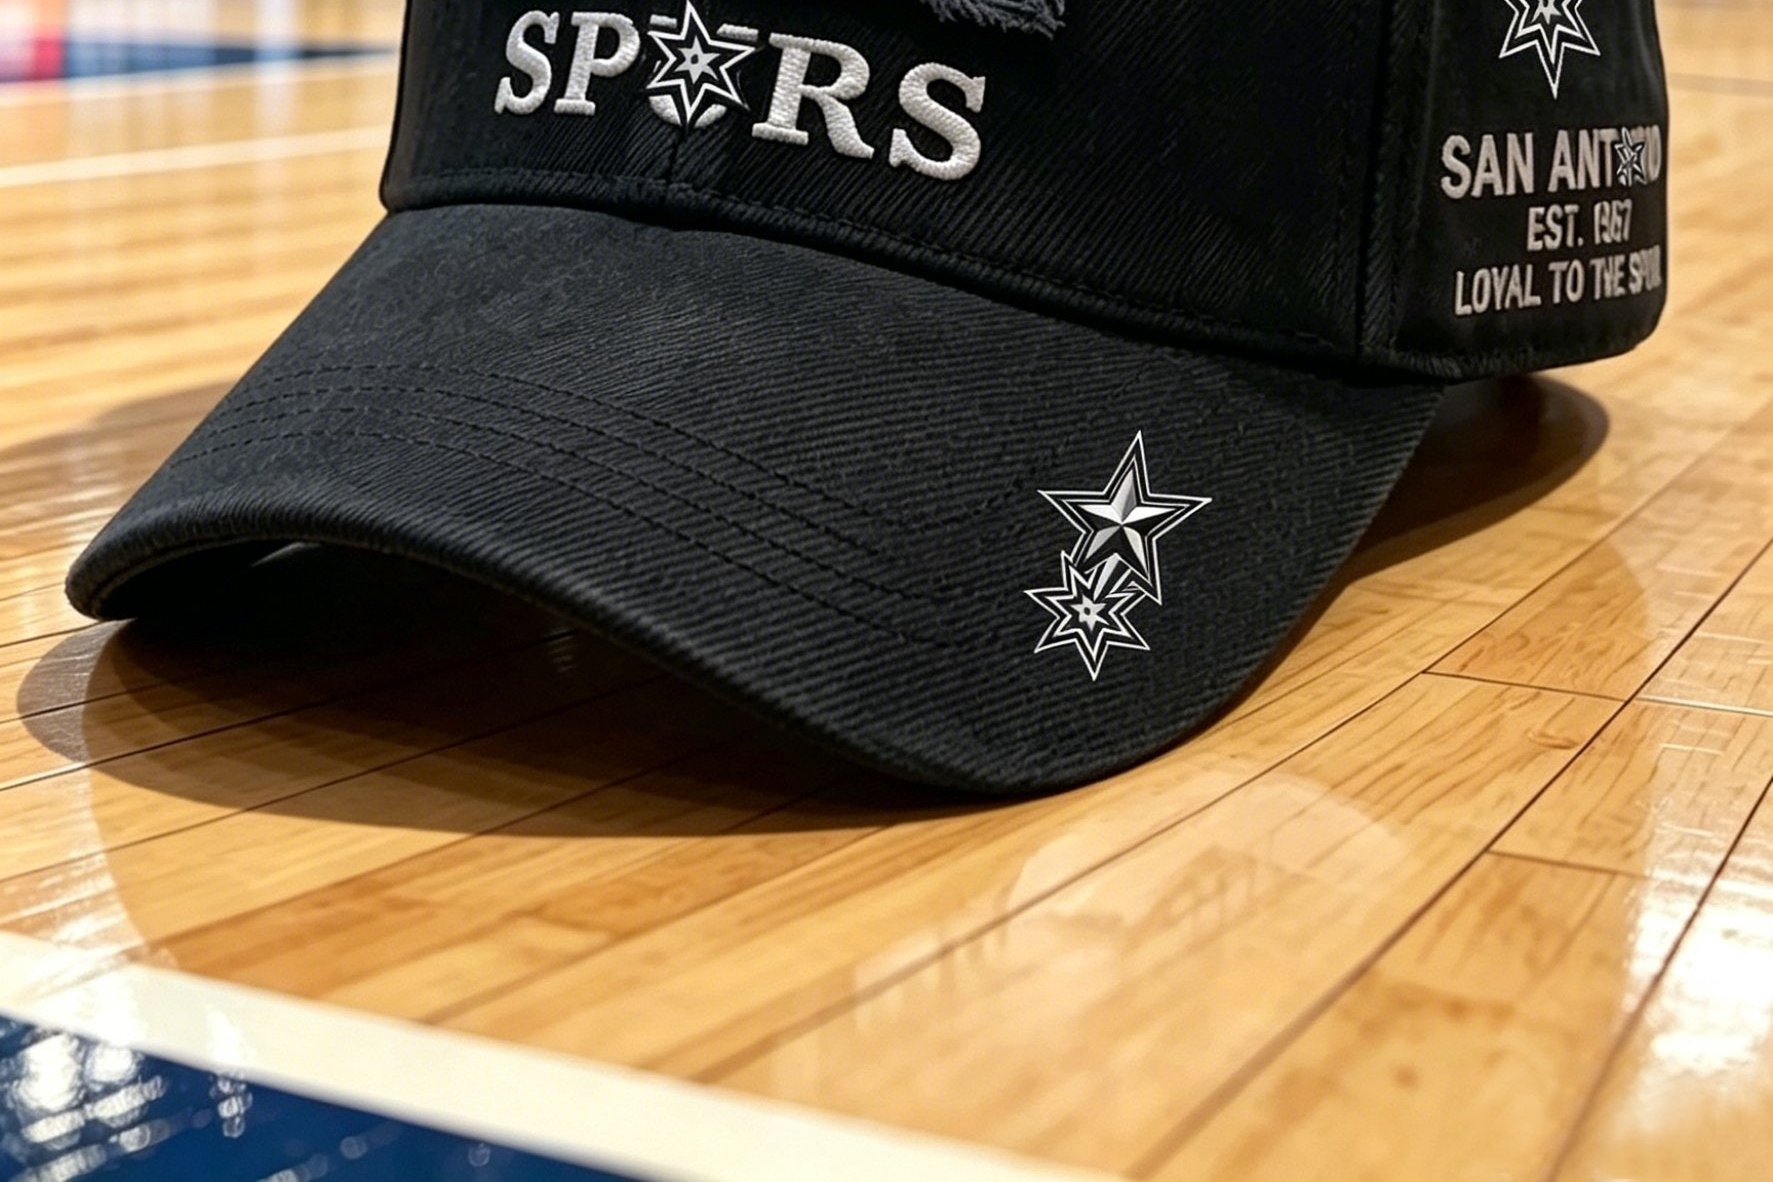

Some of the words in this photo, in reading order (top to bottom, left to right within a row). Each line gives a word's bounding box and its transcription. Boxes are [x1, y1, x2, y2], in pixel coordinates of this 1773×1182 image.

[1441, 132, 1535, 199] SAN
[1527, 204, 1584, 251] EST.
[1455, 264, 1542, 316] LOYAL
[1548, 259, 1585, 304] TO
